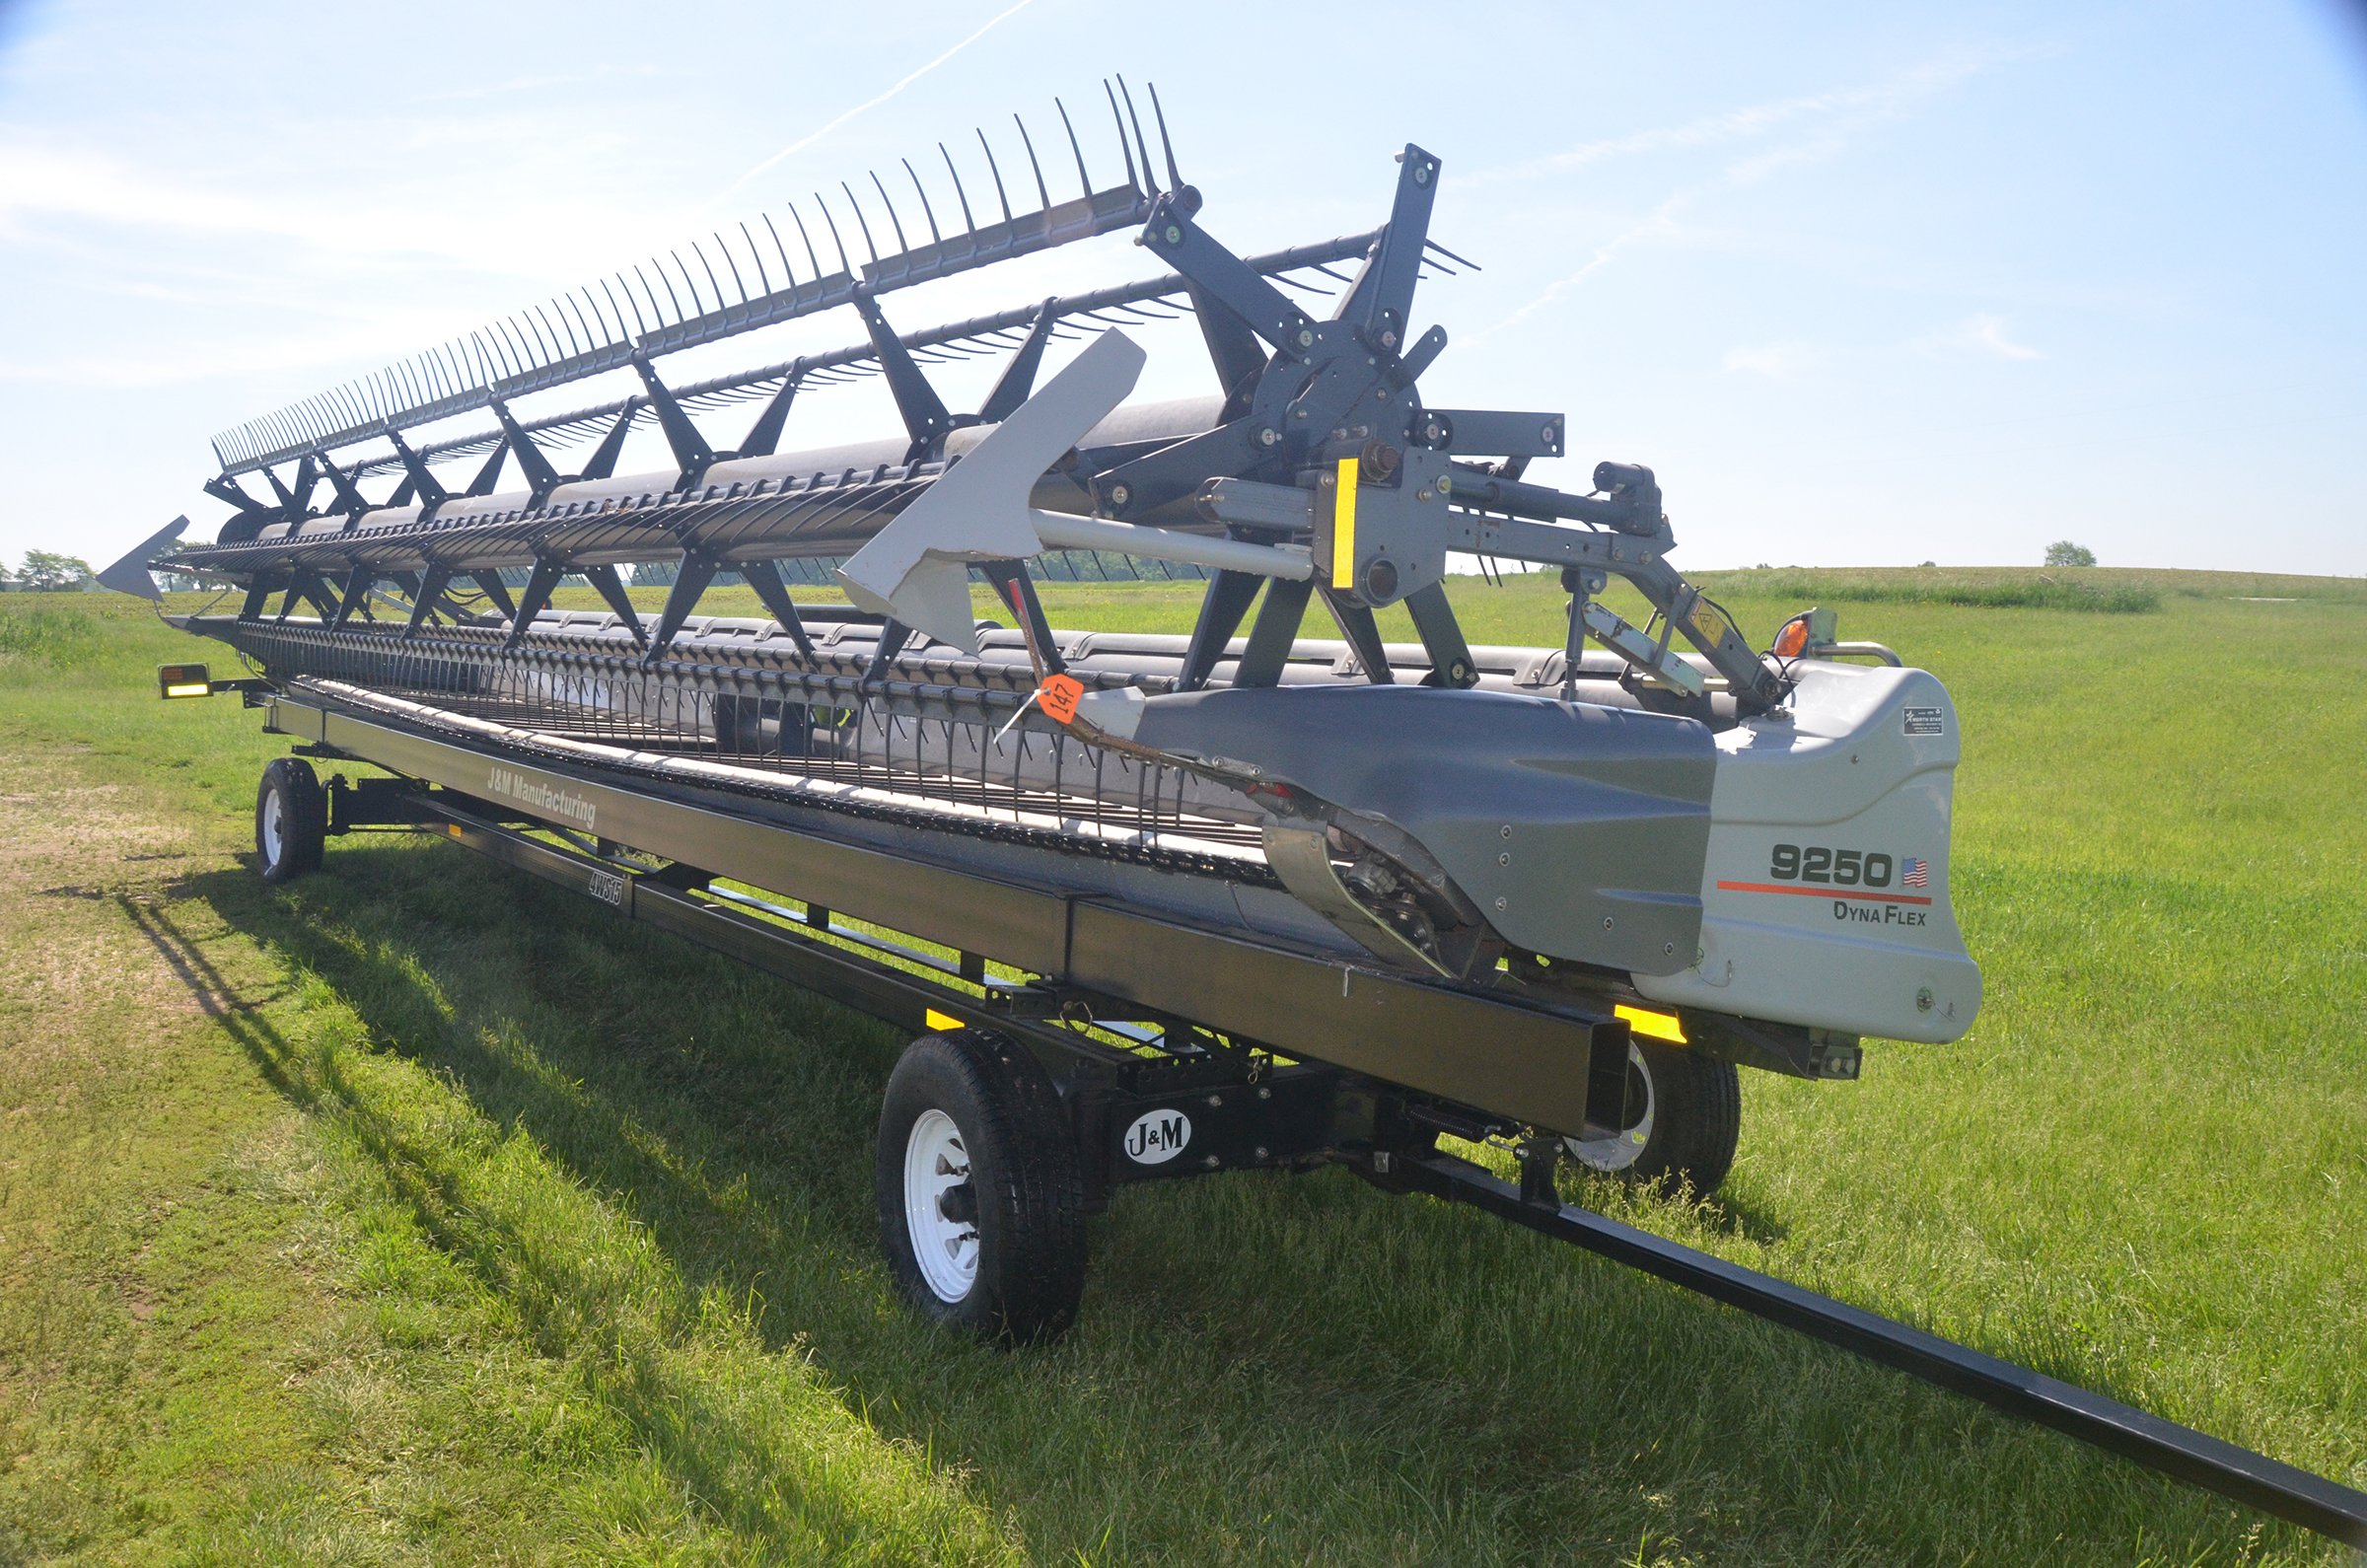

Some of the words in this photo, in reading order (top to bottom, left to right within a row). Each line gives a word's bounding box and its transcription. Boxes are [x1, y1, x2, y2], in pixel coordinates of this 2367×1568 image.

[1049, 682, 1074, 714] 147
[487, 766, 511, 795] J&M
[512, 774, 597, 829] Manufacturing
[1770, 843, 1893, 888] 9250
[589, 872, 622, 905] 4WS15
[1128, 1116, 1184, 1156] J&M
